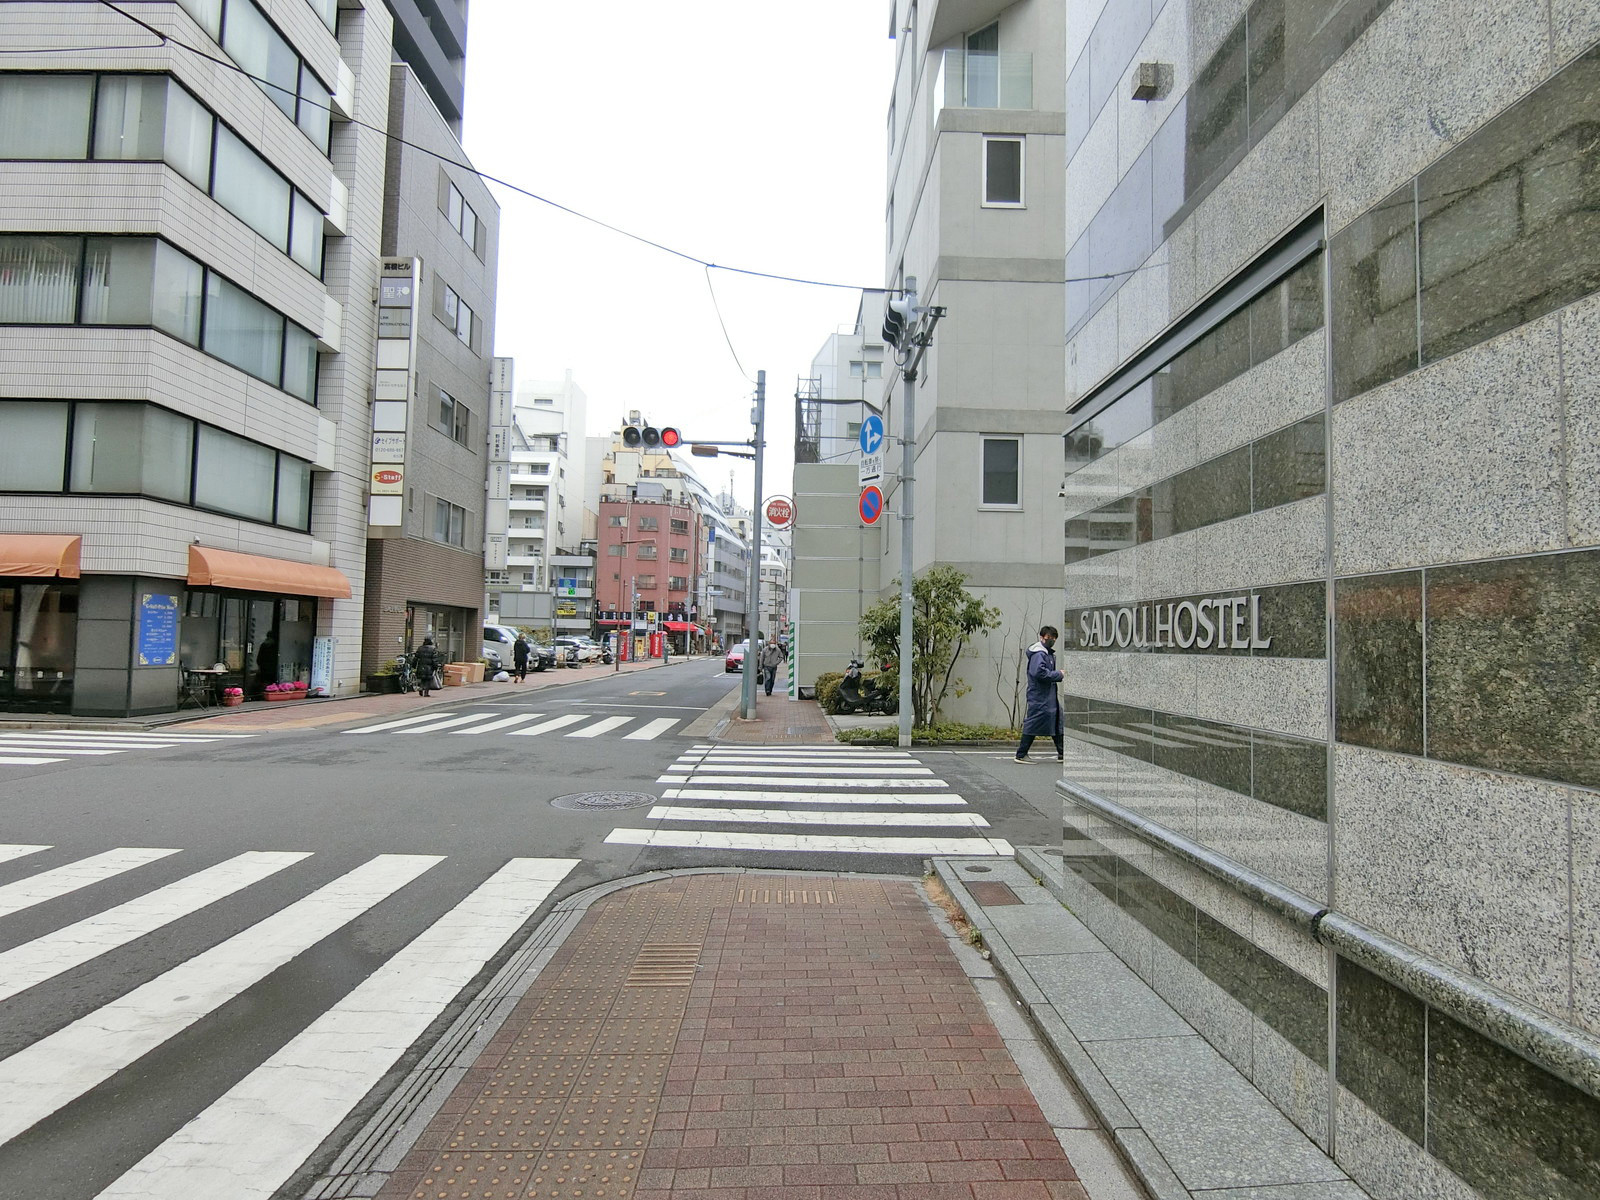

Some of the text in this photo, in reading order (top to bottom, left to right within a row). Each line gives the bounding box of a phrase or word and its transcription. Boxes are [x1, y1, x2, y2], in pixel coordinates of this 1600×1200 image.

[768, 507, 790, 518] 消火栓
[1080, 594, 1274, 649] SADOU HOSTEL
